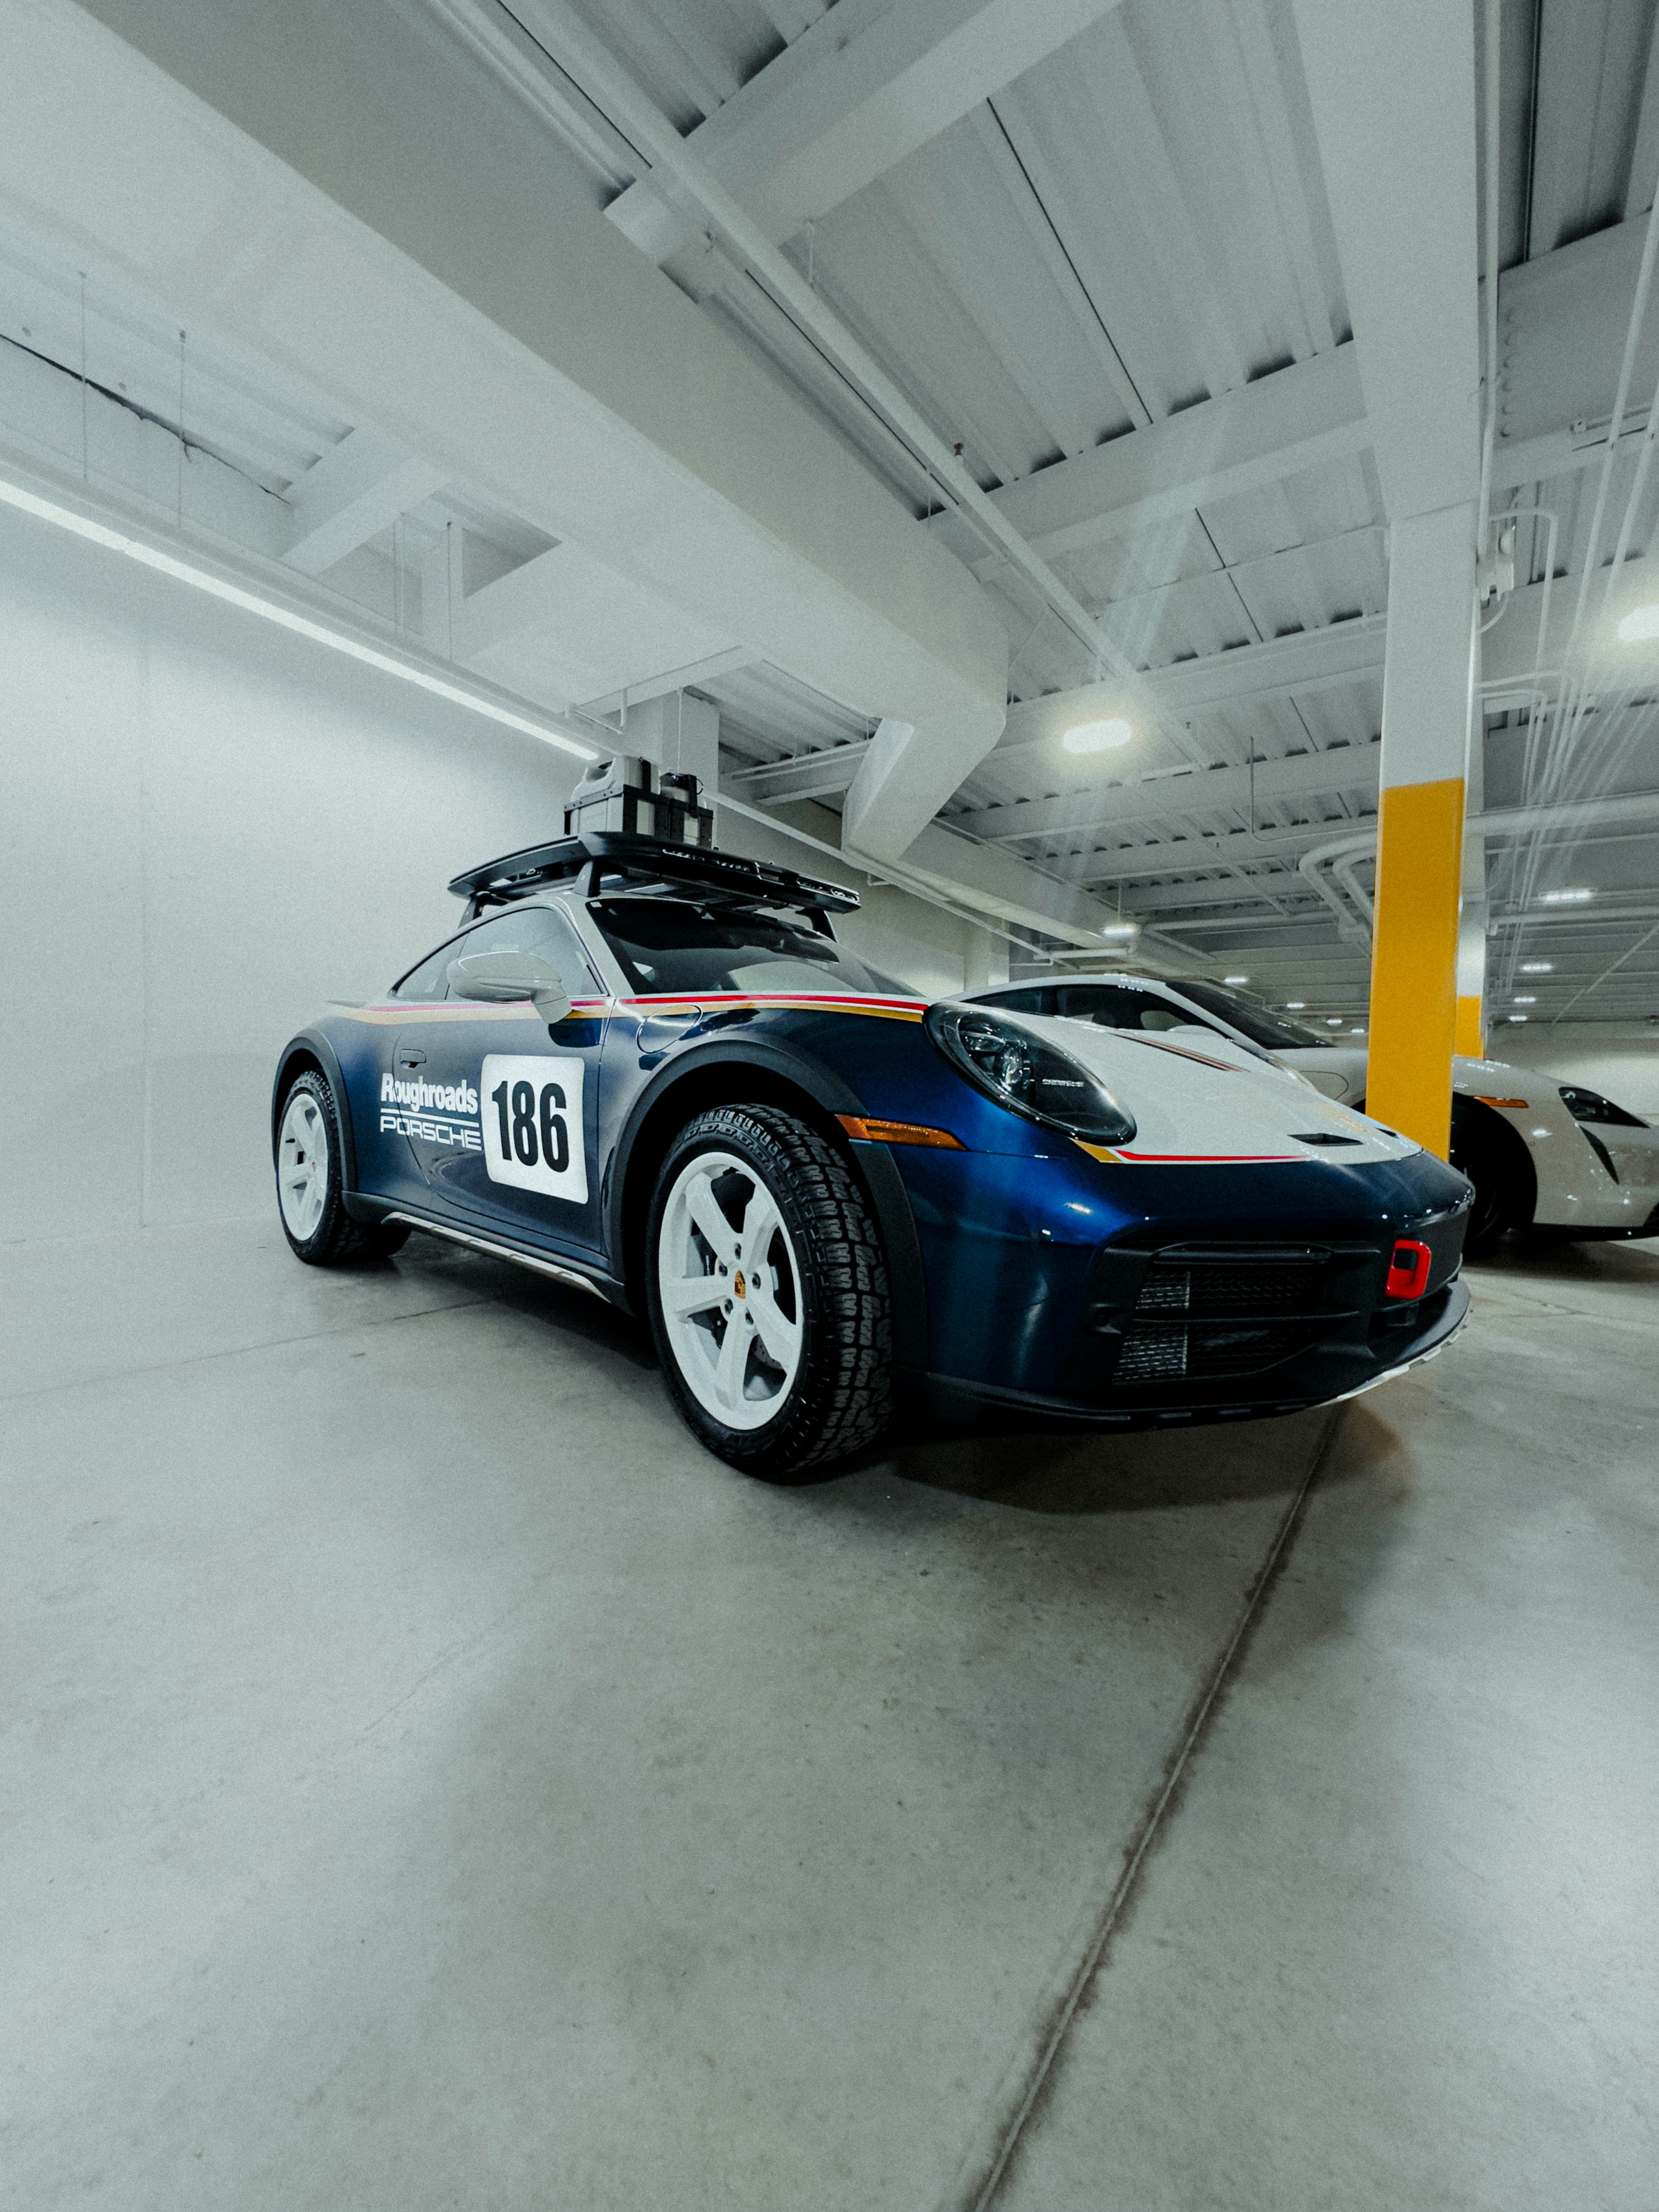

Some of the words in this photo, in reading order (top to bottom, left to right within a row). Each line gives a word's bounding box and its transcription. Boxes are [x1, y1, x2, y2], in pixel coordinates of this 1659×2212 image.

[380, 1073, 478, 1115] Roughroads
[380, 1115, 483, 1151] PORSCHE
[492, 1080, 569, 1173] 186
